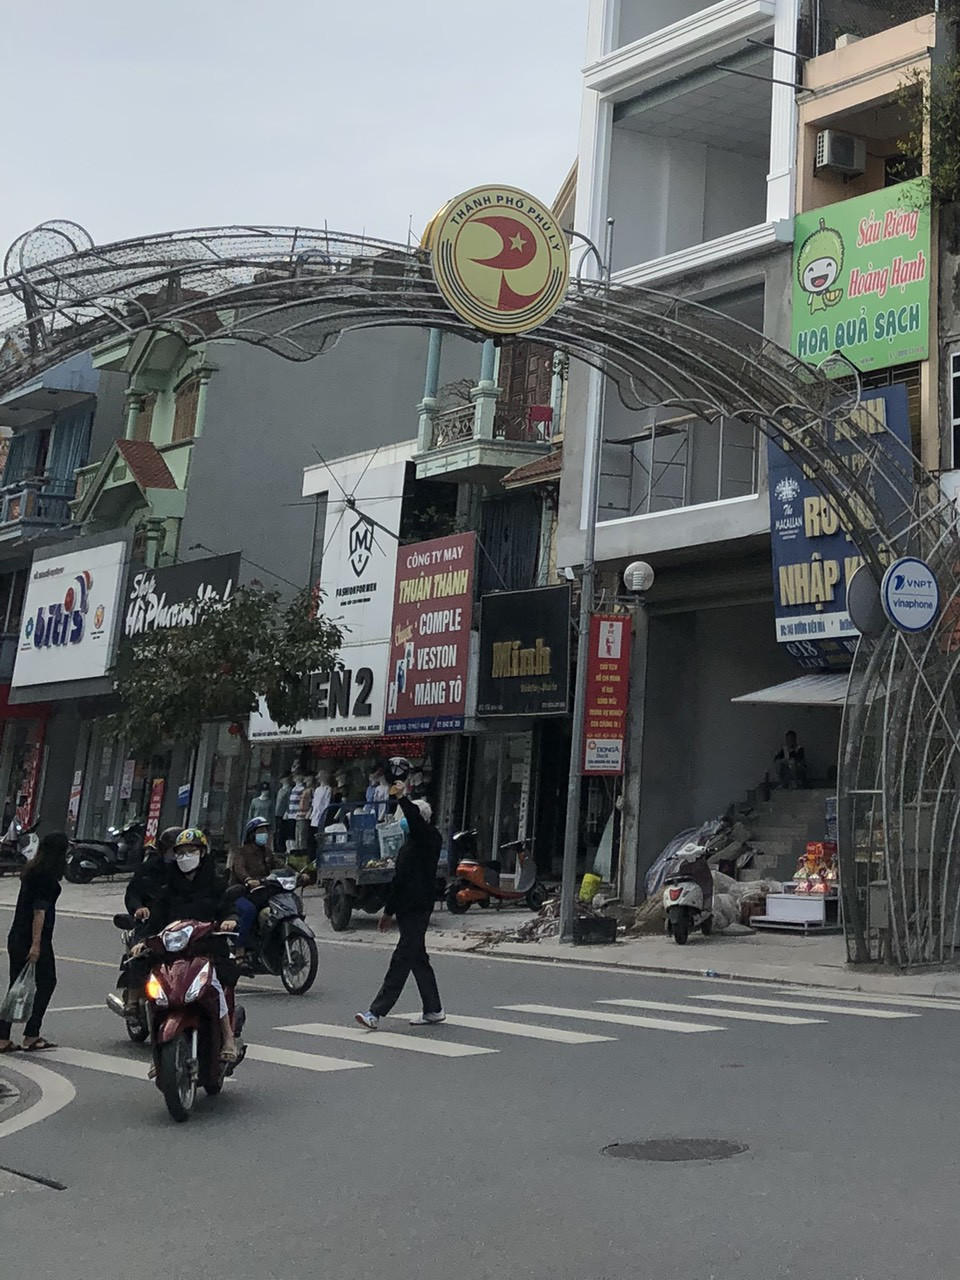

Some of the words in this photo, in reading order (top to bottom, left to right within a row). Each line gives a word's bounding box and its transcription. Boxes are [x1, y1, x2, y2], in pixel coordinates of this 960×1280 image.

[451, 196, 491, 225] THÀNH
[496, 195, 525, 209] PHỐ
[528, 207, 552, 232] PHỦ
[857, 209, 881, 247] Sầu
[883, 208, 918, 239] Riêng
[848, 264, 889, 299] Hoàng
[890, 250, 925, 293] Hạnh
[798, 326, 829, 357] HOA
[835, 308, 868, 349] QUẢ
[874, 304, 920, 343] SẠCH
[406, 551, 431, 569] CÔNG
[431, 552, 443, 563] TY
[443, 546, 464, 561] MAY
[398, 573, 432, 608] THUẬN
[778, 552, 840, 611] NHẬP
[907, 579, 933, 589] VNPT
[418, 608, 462, 636] COMPLE
[893, 599, 933, 610] vinaphone
[417, 644, 457, 670] VESTON
[491, 638, 551, 678] Minh
[352, 667, 374, 717] 2
[414, 677, 446, 706] MĂNG
[449, 674, 463, 703] TÔ
